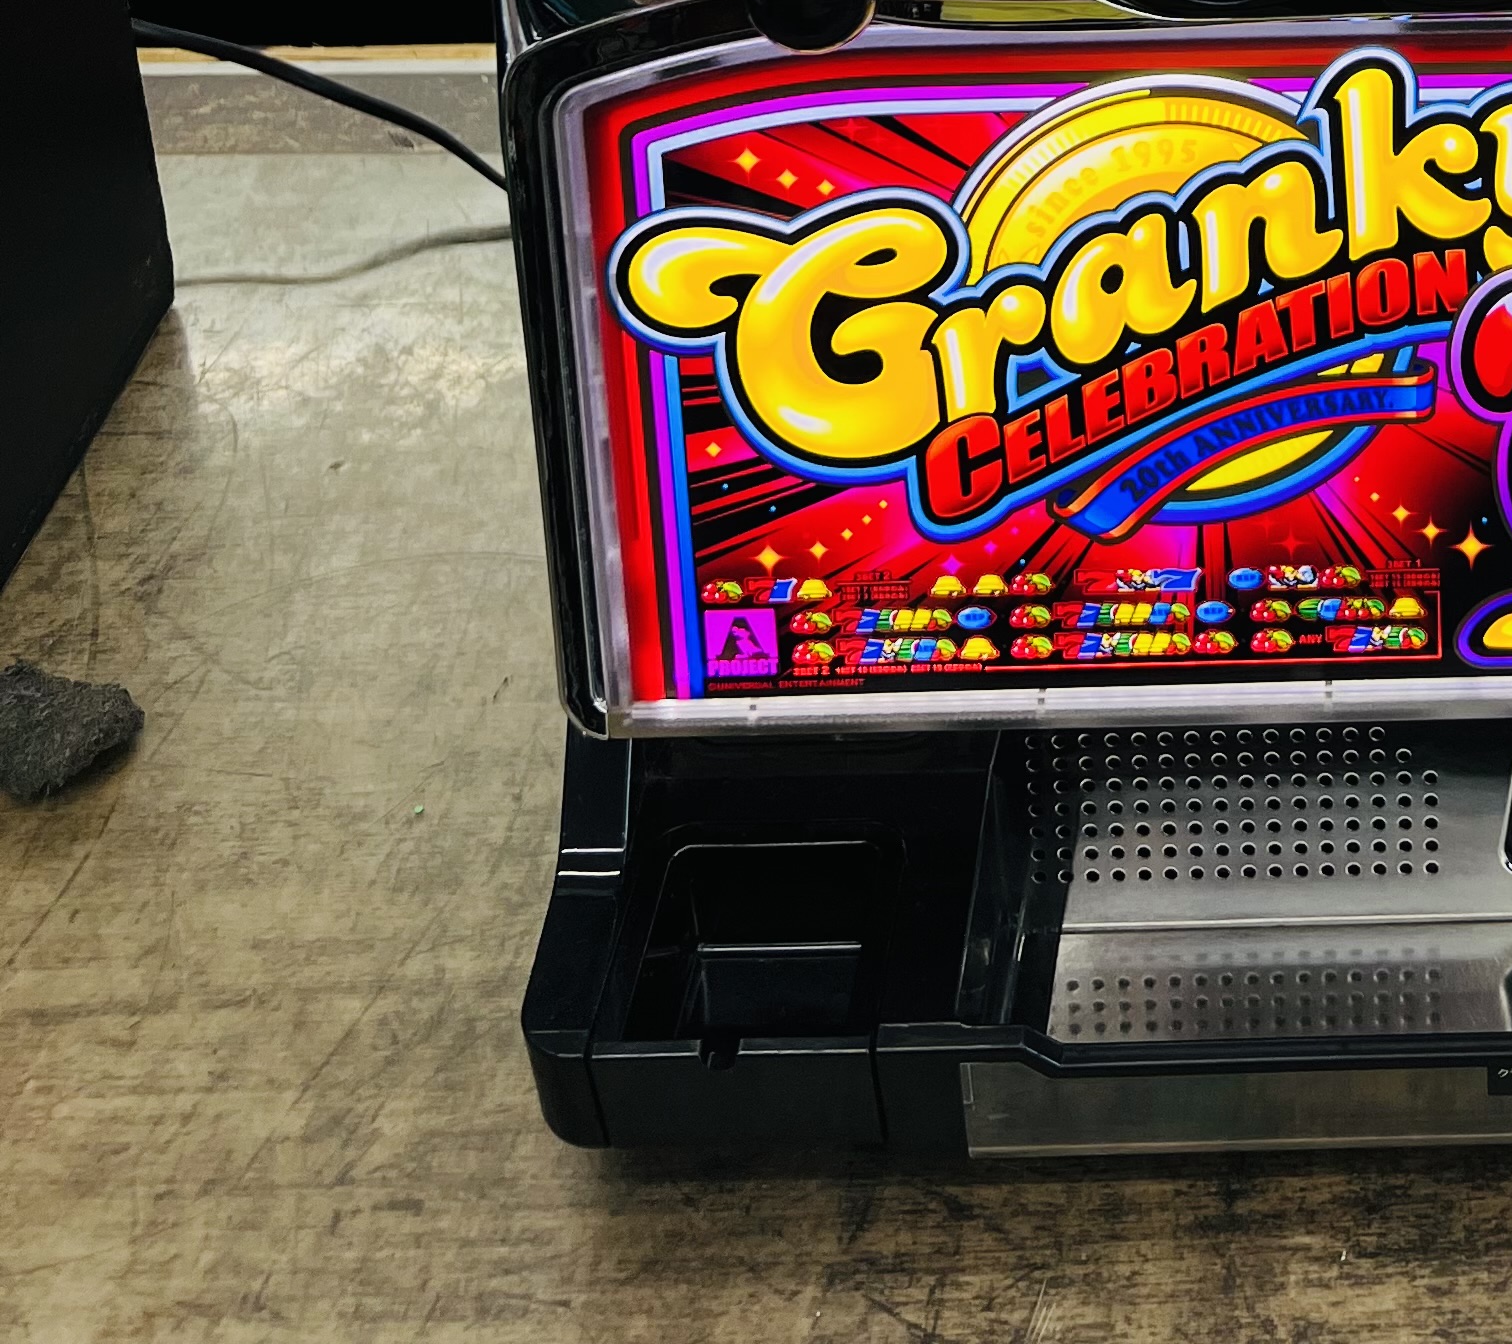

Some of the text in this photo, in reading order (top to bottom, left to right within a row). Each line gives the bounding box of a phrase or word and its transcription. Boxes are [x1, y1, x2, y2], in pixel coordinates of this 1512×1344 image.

[1026, 138, 1199, 238] since 1995
[925, 248, 1469, 518] CELEBRATION
[1119, 450, 1195, 503] 20th
[706, 659, 779, 676] PROJECT
